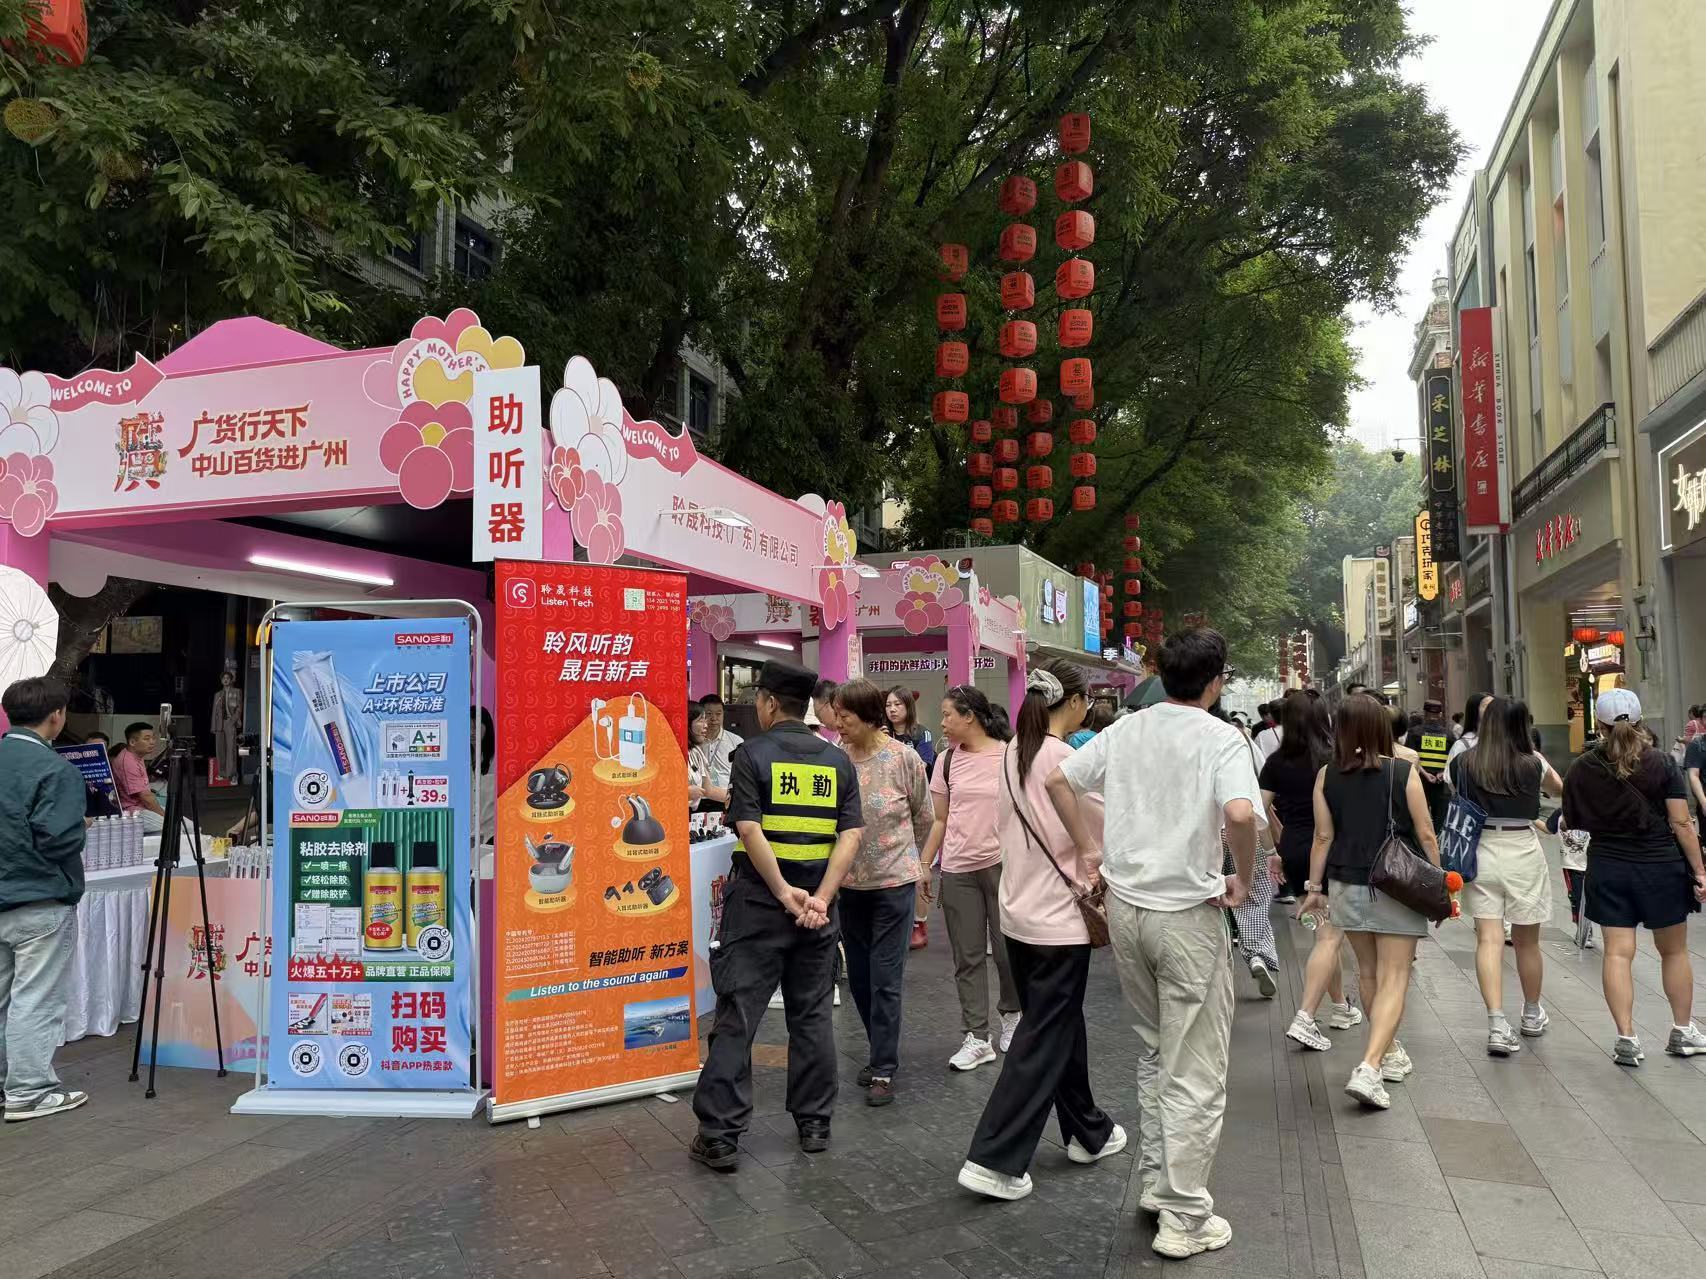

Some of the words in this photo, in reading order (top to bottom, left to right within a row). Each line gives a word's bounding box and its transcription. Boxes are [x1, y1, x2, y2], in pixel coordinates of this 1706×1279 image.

[401, 350, 421, 399] HAPPY
[427, 343, 486, 373] MOTHER'S
[52, 379, 113, 401] WELCOME
[115, 378, 132, 396] TO
[177, 402, 311, 459] 广货行天下
[623, 424, 668, 459] WELCOME
[669, 446, 680, 461] TO
[192, 439, 348, 478] 中山百货进广州
[487, 392, 527, 545] 助听器
[541, 584, 592, 597] 聆晟科技
[541, 597, 568, 607] Listen
[570, 598, 593, 608] Tech
[542, 631, 634, 655] 聆风听韵
[558, 660, 650, 682] 晟启新声
[364, 672, 447, 694] 上市公司
[362, 696, 446, 714] A+环保标准
[412, 730, 437, 744] A+
[1424, 738, 1444, 749] 执勤
[780, 772, 832, 798] 执勤
[300, 841, 368, 857] 粘胶去除剂
[311, 875, 348, 885] 轻松除胶
[311, 889, 349, 899] 赠除胶铲
[589, 946, 646, 968] 智能助听
[650, 940, 689, 959] 新方案
[290, 965, 361, 978] 火爆五十万+
[365, 966, 406, 977] 品牌直营
[409, 966, 451, 977] 正品保障
[530, 983, 565, 998] Listen
[568, 981, 580, 992] to
[582, 979, 600, 990] the
[602, 973, 637, 987] sound
[639, 970, 669, 983] again
[391, 991, 446, 1020] 扫码
[392, 1025, 447, 1054] 购买
[380, 1060, 453, 1071] 抖音APP热卖款
